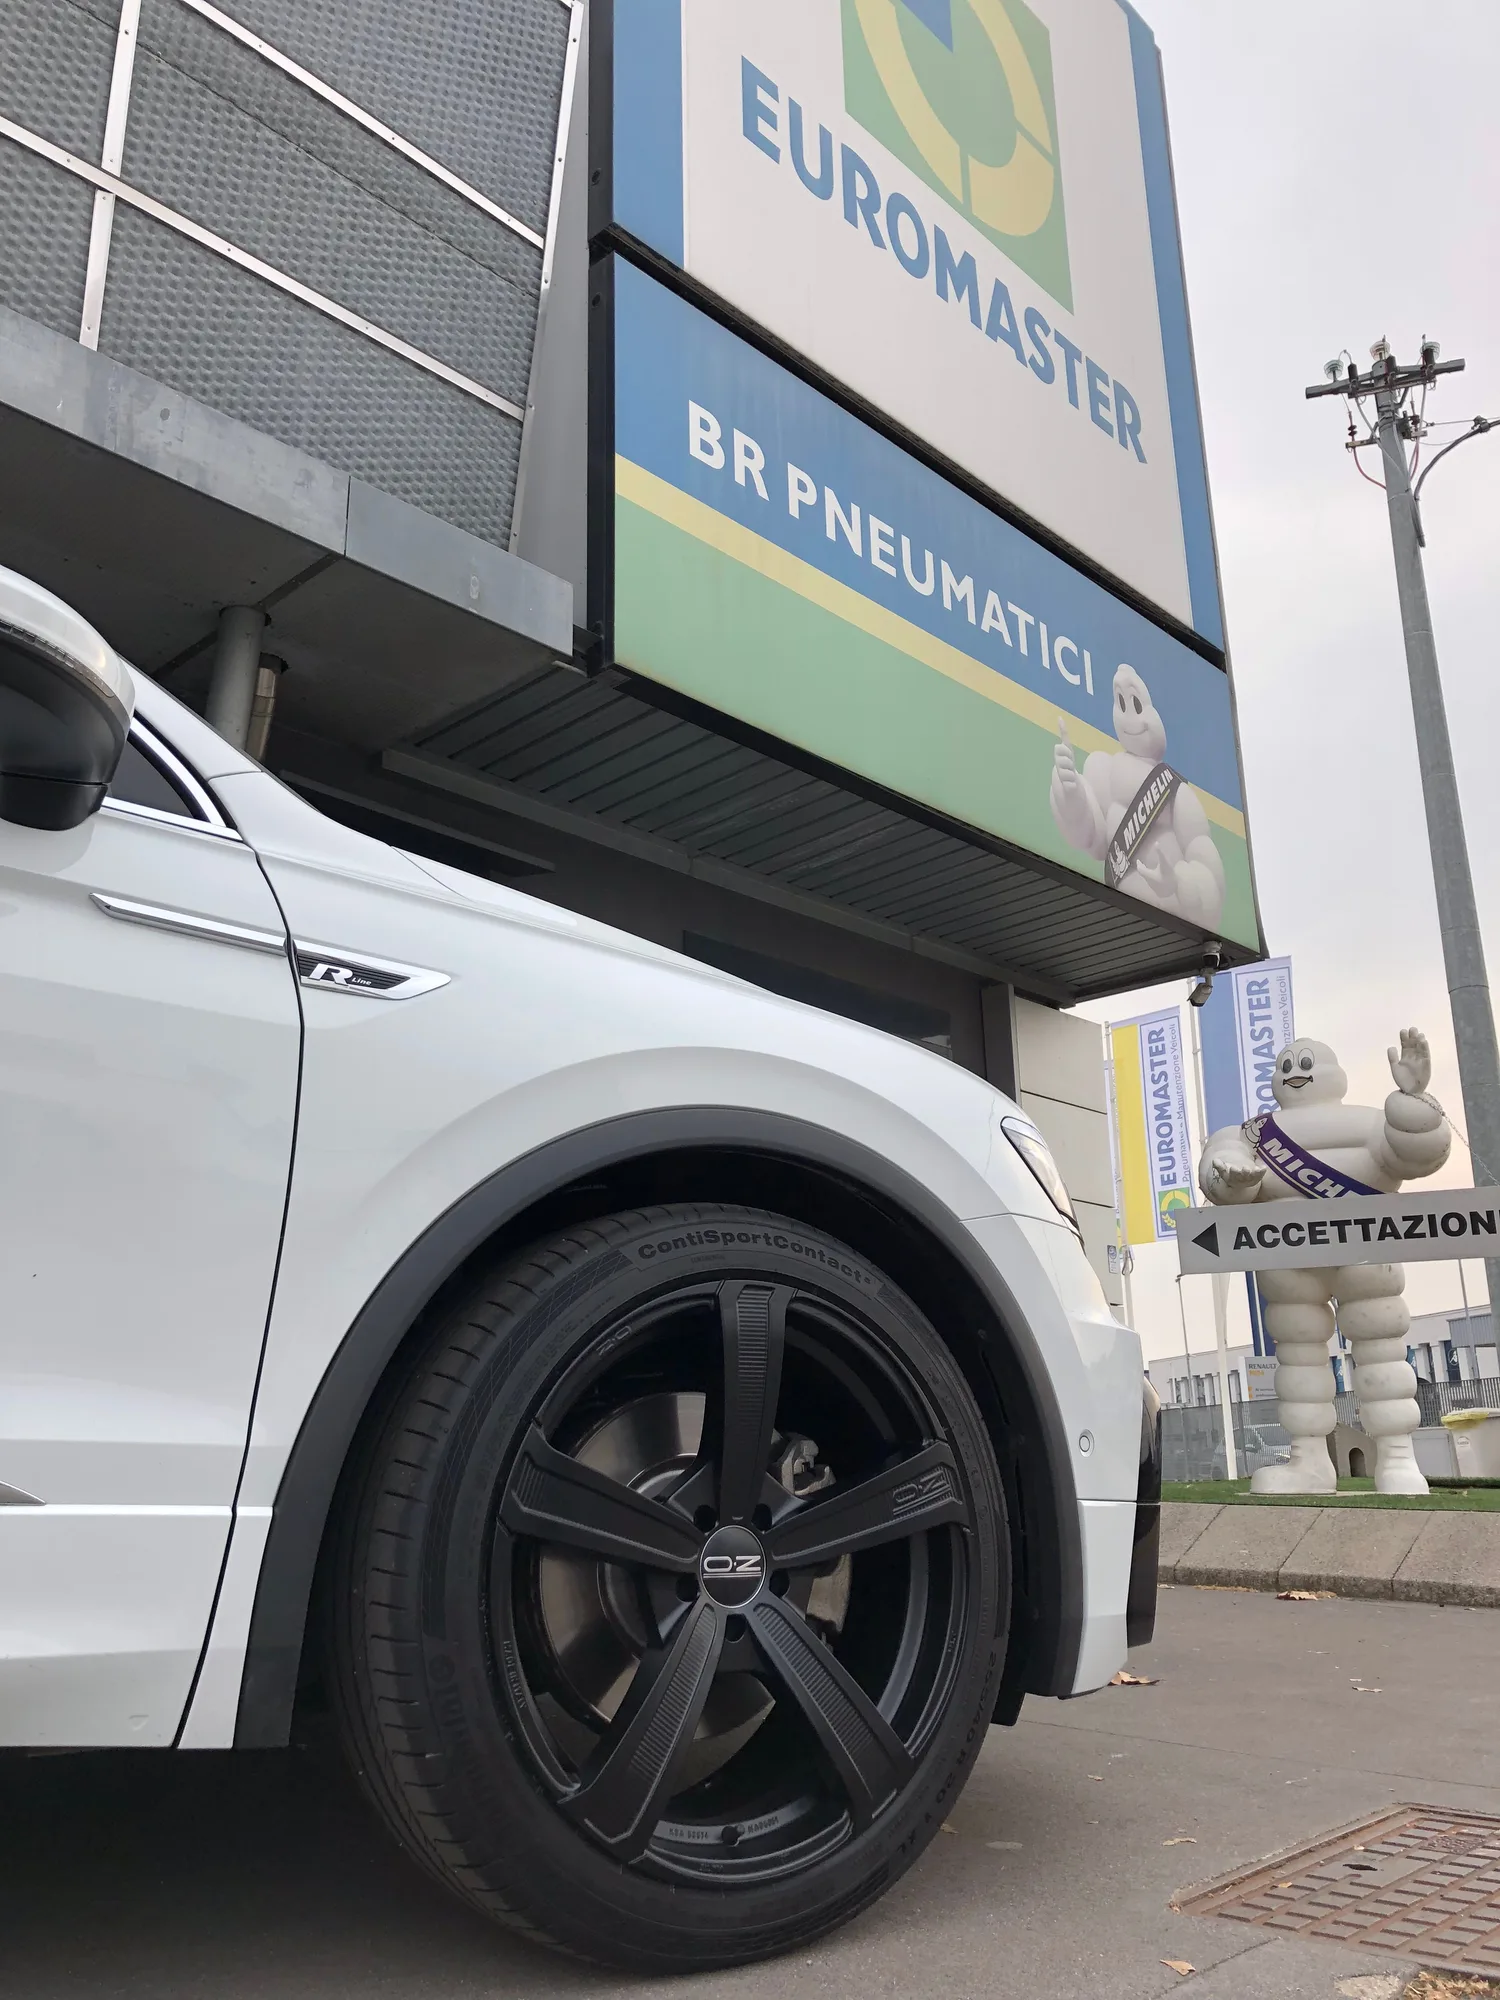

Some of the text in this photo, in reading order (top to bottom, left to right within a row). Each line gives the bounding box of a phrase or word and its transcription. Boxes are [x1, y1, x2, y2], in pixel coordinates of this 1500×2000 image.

[741, 54, 1148, 464] EUROMASTER
[688, 400, 1094, 696] BR PNEUMATICI
[1123, 768, 1174, 850] MICHELIN
[1147, 1026, 1177, 1187] EUROMASTER
[1246, 976, 1282, 1116] ROMASTER
[1233, 1209, 1500, 1250] ACCETTAZION
[1262, 1137, 1361, 1199] MICH
